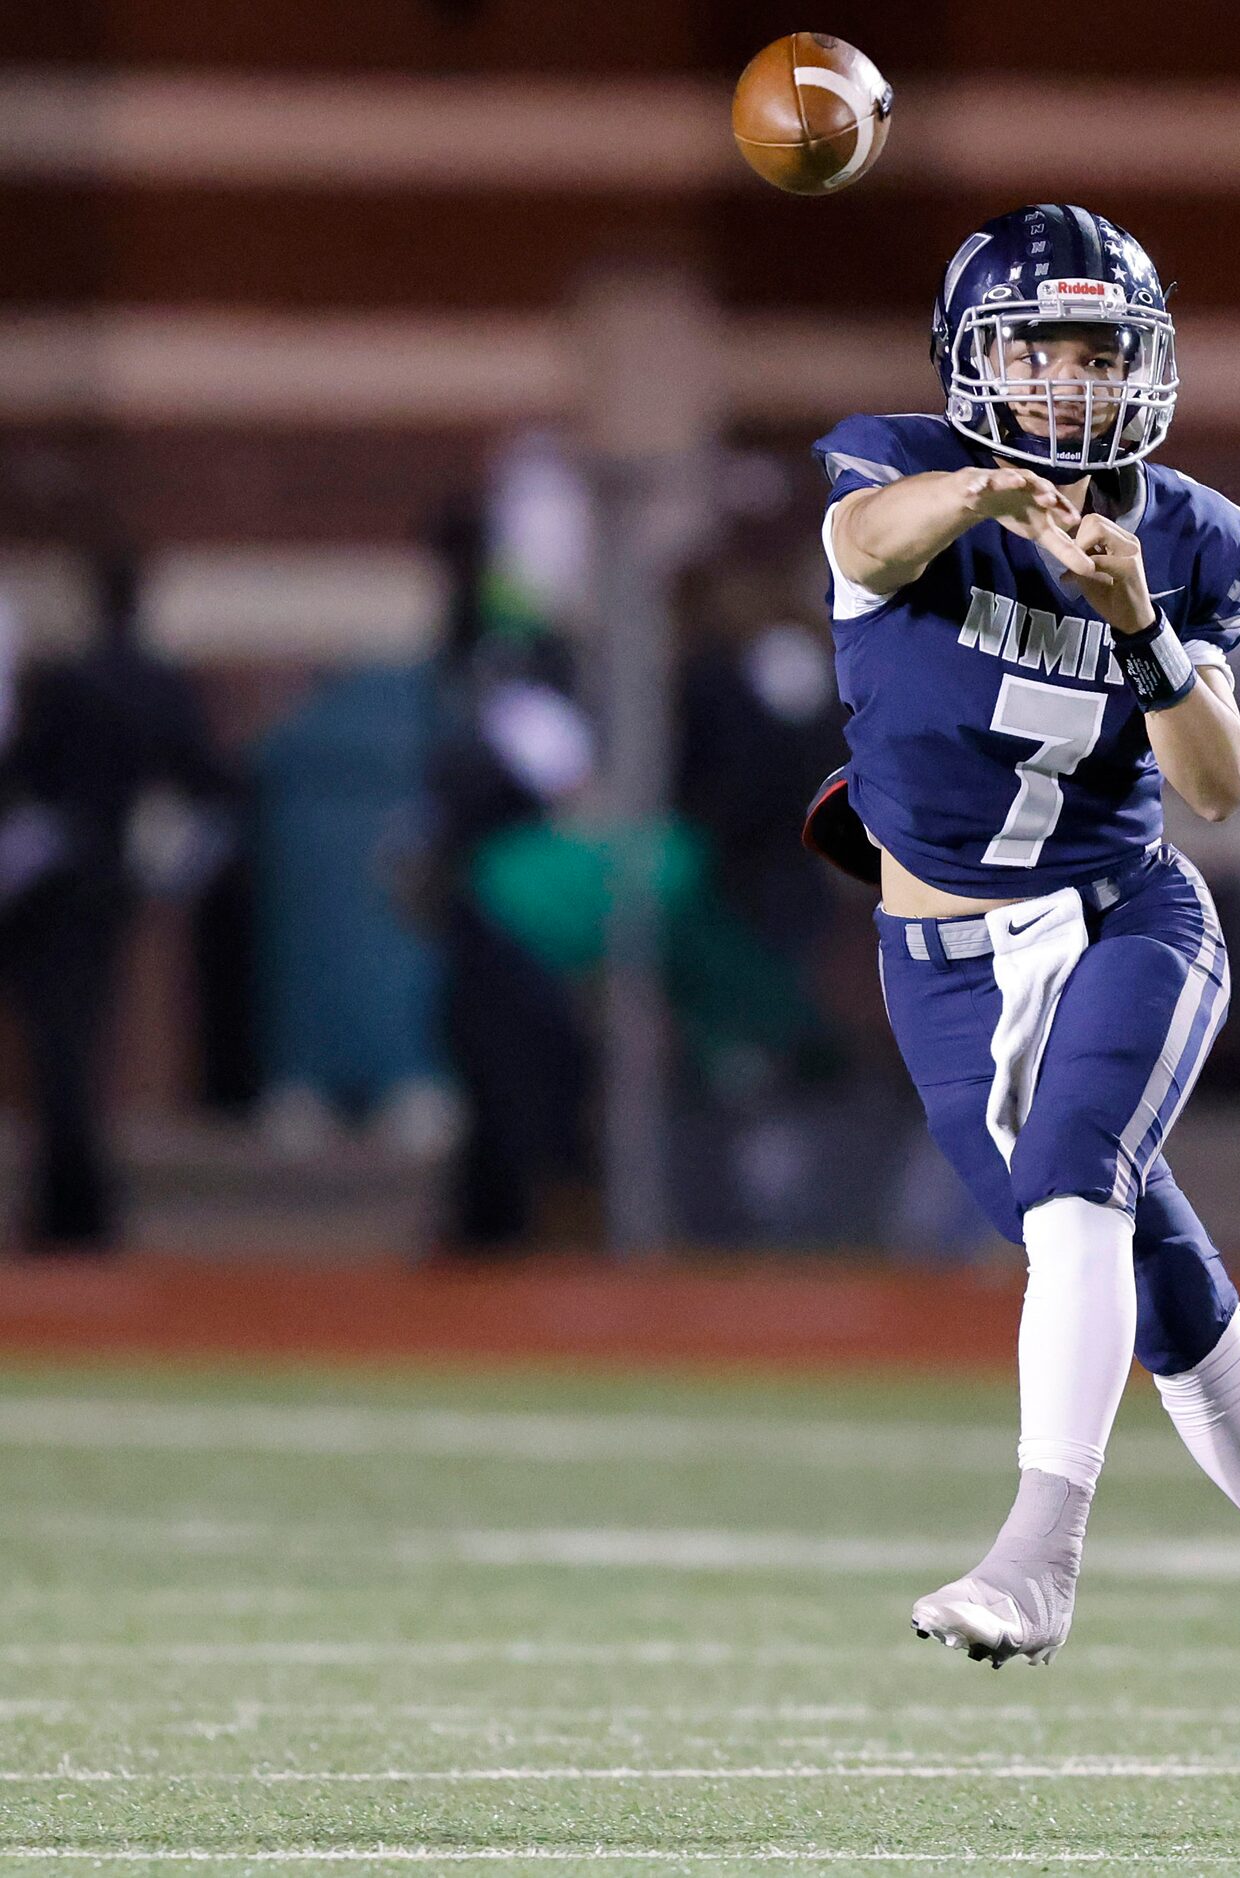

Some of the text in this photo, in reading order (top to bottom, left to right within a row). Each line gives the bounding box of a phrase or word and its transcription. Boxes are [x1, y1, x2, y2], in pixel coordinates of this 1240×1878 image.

[1031, 224, 1044, 235] N
[1032, 241, 1046, 253] N
[1010, 266, 1022, 281] N
[1035, 263, 1049, 276] N
[1058, 282, 1104, 295] Riddell
[1056, 451, 1081, 460] iddell
[957, 585, 1125, 685] NIMIT
[980, 672, 1108, 868] 7
